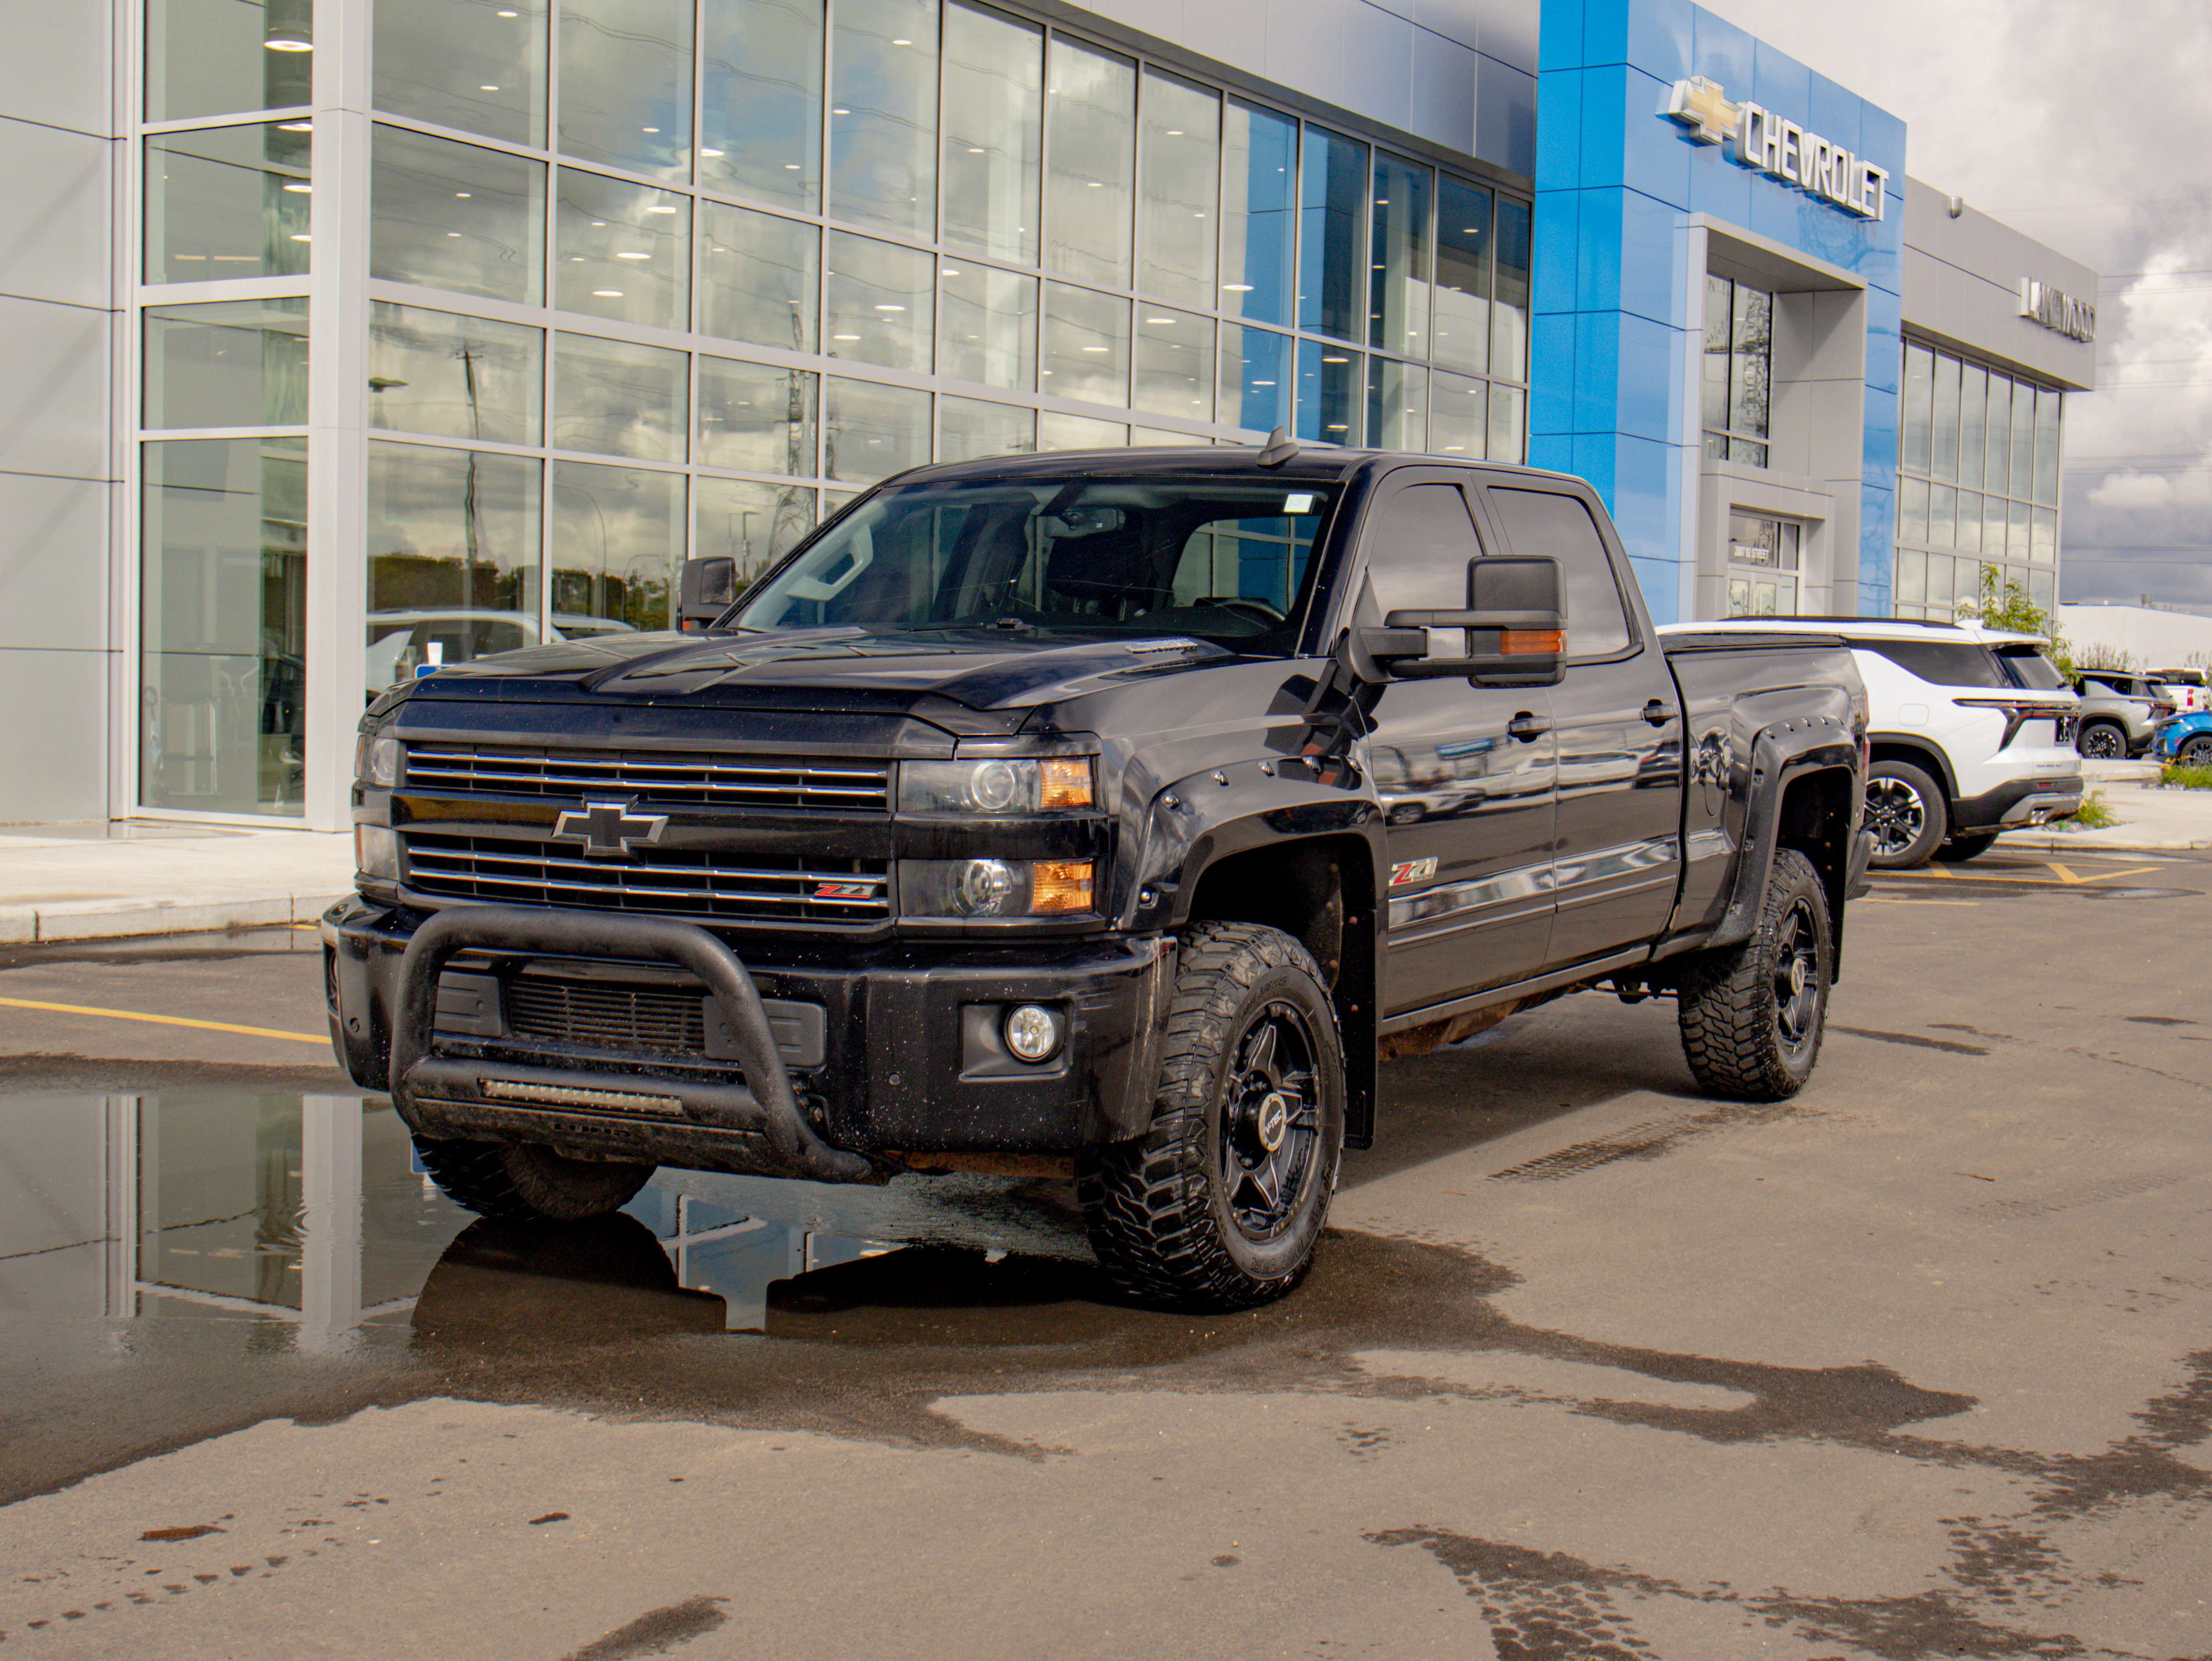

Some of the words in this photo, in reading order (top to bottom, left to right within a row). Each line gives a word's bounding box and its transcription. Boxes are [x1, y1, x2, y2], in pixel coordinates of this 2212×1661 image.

[1737, 101, 1889, 221] CHEVROLET
[1389, 857, 1438, 887] Z71
[814, 883, 878, 899] Z71
[1265, 1109, 1282, 1134] V-TEC
